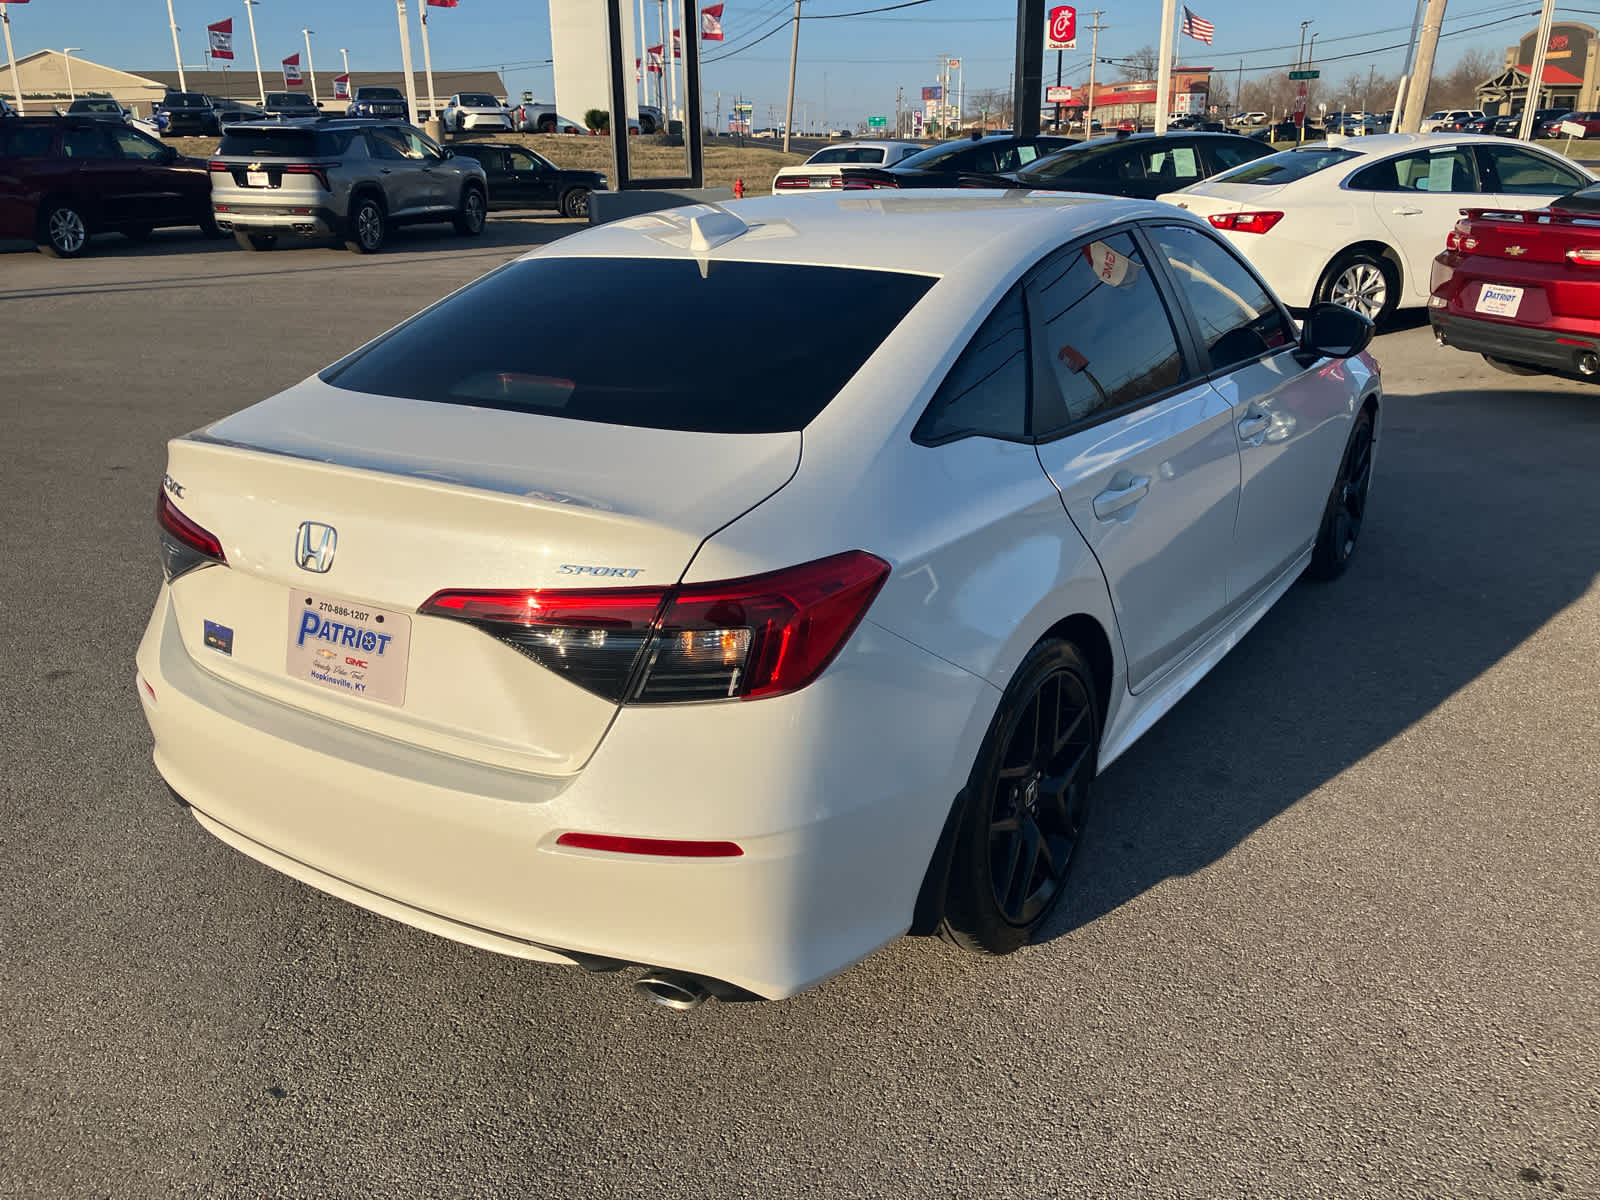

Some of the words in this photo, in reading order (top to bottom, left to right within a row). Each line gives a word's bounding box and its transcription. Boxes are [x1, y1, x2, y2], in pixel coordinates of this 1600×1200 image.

[1482, 289, 1517, 302] PATRIOT
[556, 564, 646, 579] SPORT
[297, 609, 393, 656] PATRIOT
[345, 656, 368, 669] GMC
[311, 670, 353, 690] Hopkinsville,
[355, 683, 366, 693] KY
